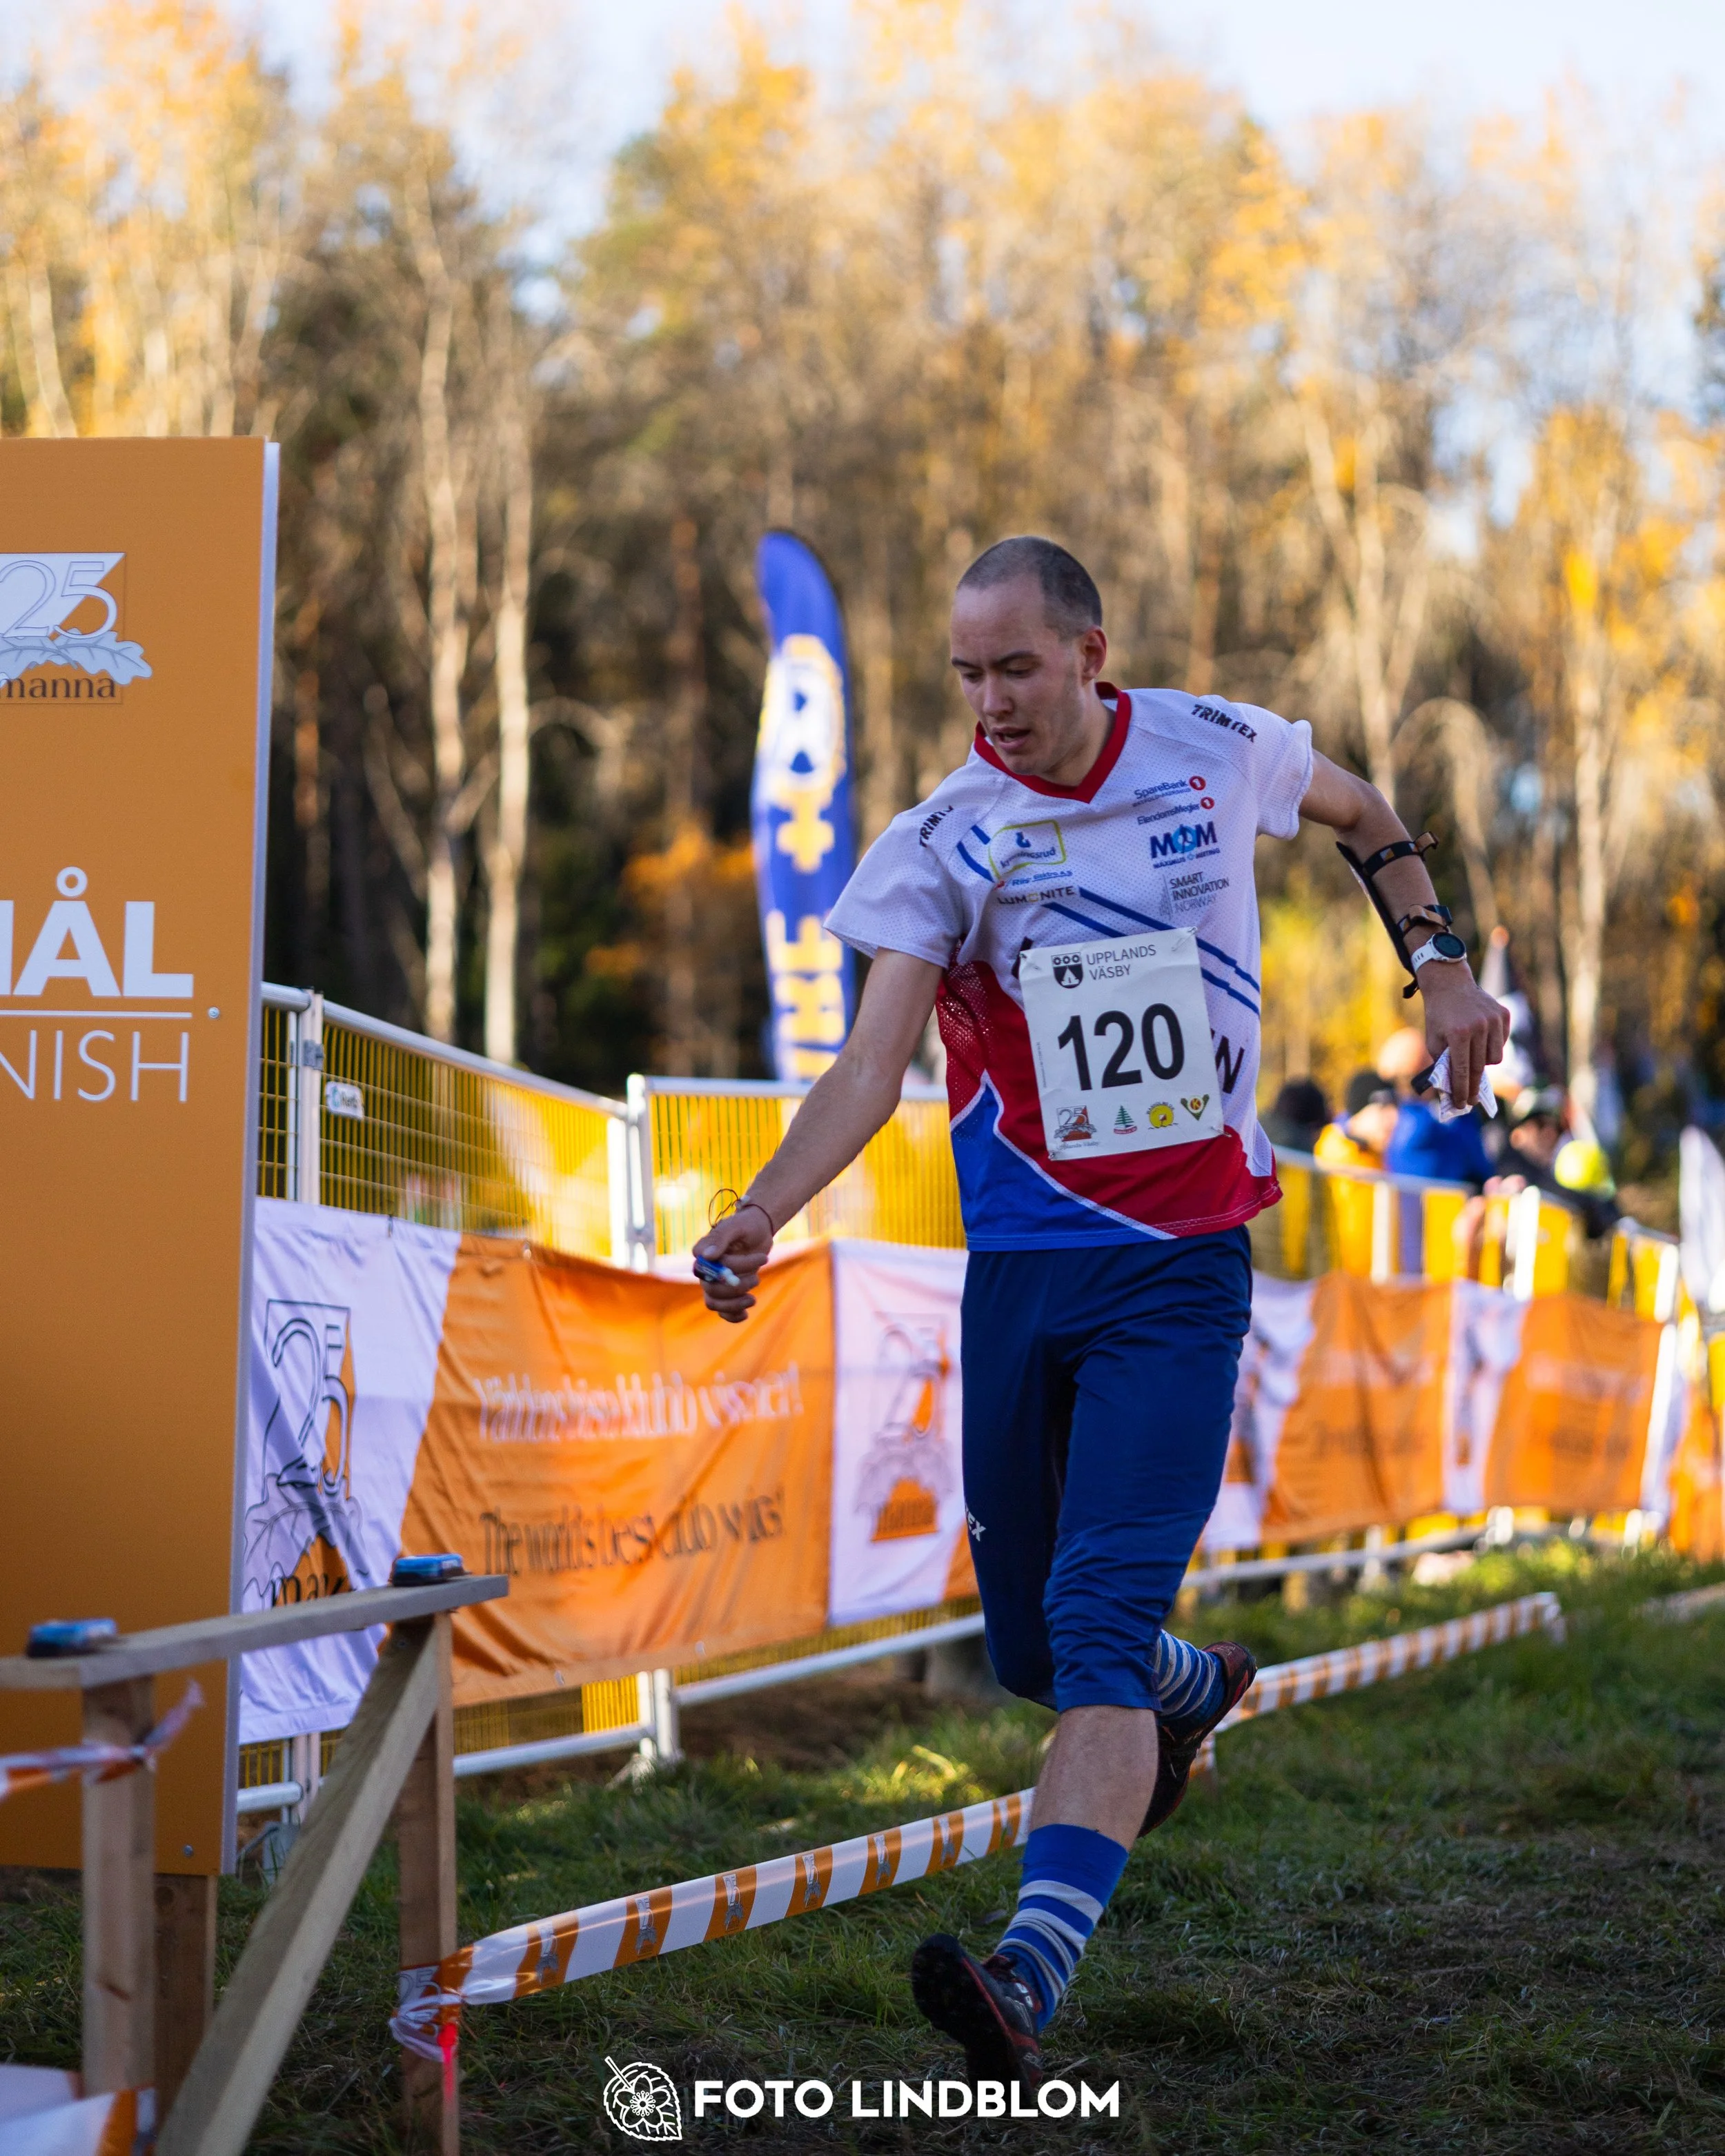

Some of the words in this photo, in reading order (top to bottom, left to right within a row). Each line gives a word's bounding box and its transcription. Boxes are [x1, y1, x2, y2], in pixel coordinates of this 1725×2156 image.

[0, 560, 117, 640] 25
[0, 675, 117, 700] manna
[1191, 704, 1257, 743] TRIMTEX
[1134, 780, 1188, 799] SpareBank
[1170, 871, 1203, 889] SMART
[1172, 877, 1230, 901] INNOVATION
[1174, 894, 1217, 912] NORWAY
[1086, 945, 1156, 965] UPPLANDS
[1089, 964, 1131, 980] VÄSBY
[1058, 1002, 1185, 1091] 120
[1059, 1107, 1087, 1127] 25
